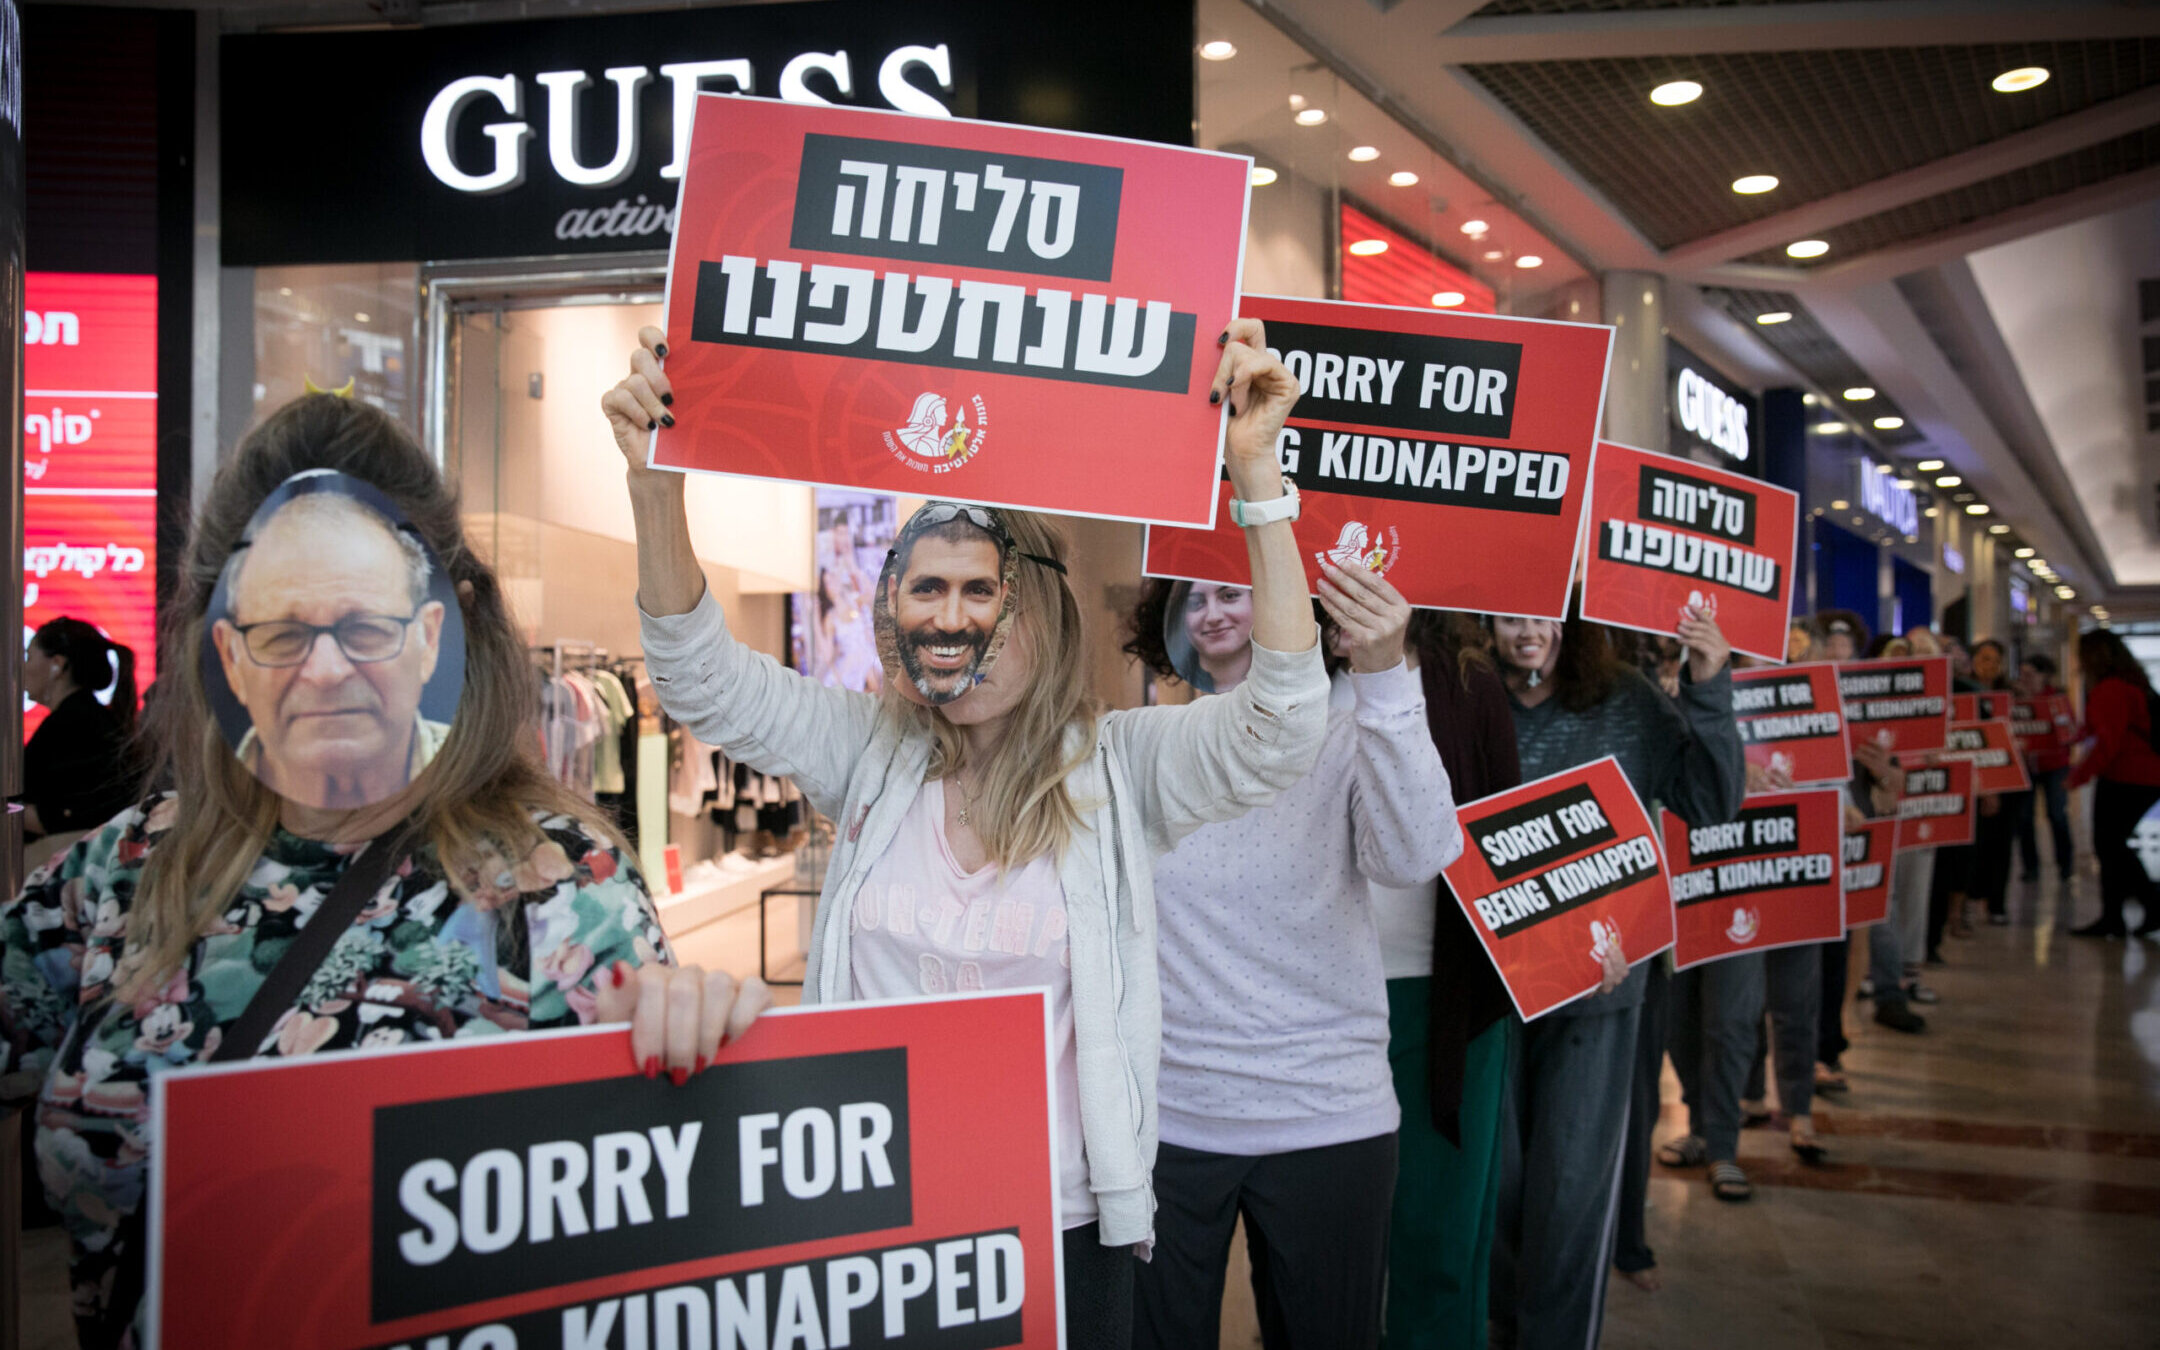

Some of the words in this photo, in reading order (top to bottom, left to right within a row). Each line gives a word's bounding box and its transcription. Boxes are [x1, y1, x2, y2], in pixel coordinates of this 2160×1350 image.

[831, 159, 1081, 260] סליחה
[720, 254, 1172, 378] שנחטפנו
[1419, 362, 1509, 417] FOR
[1678, 367, 1750, 462] GUESS
[1317, 431, 1572, 500] KIDNAPPED
[1652, 477, 1745, 536] סליחה
[1608, 518, 1776, 594] שנחטפנו
[1731, 685, 1776, 712] ORRY
[1752, 711, 1841, 740] KIDNAPPED
[1481, 813, 1561, 867] SORRY
[1555, 799, 1608, 839] FOR
[1689, 821, 1747, 856] SORRY
[1752, 816, 1796, 846] FOR
[1472, 878, 1551, 932] BEING
[1543, 834, 1659, 904] KIDNAPPED
[1717, 852, 1833, 892] KIDNAPPED
[397, 1121, 704, 1268] SORRY
[737, 1101, 897, 1208] FOR
[561, 1231, 1026, 1350] KIDNAPPED
